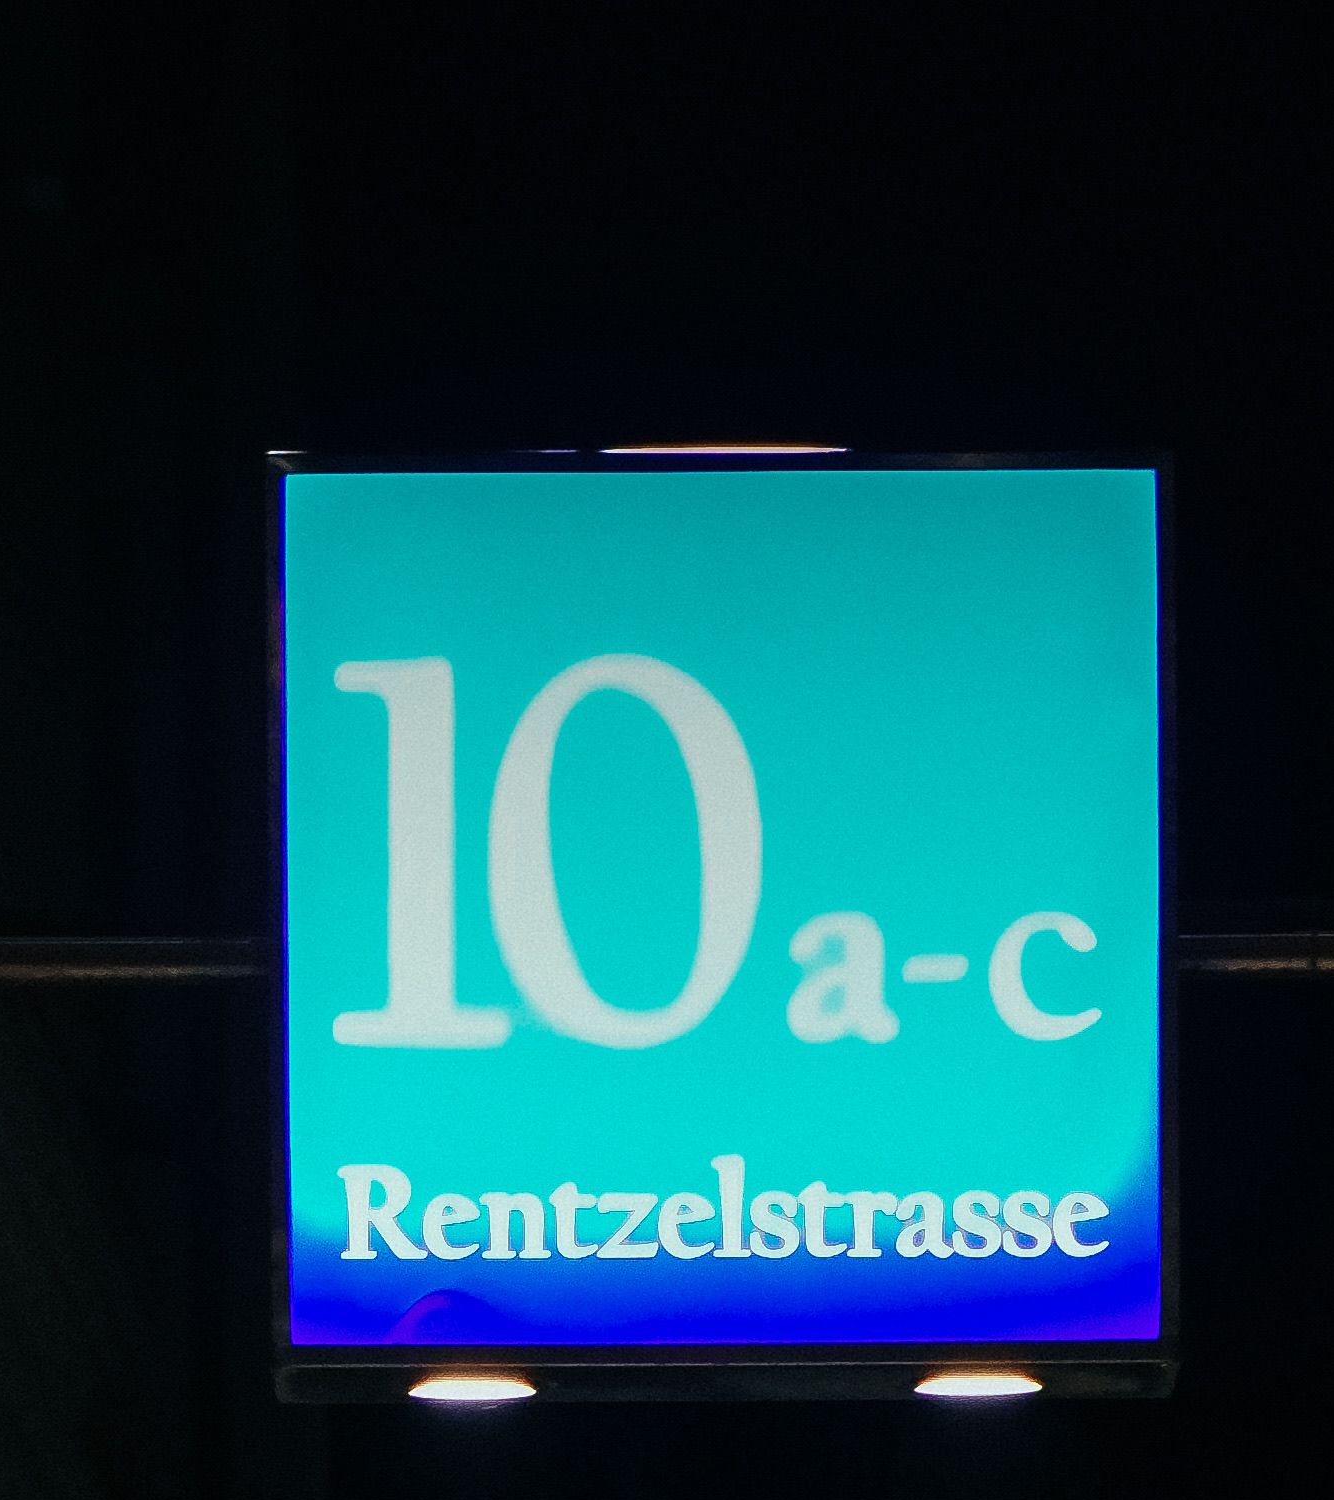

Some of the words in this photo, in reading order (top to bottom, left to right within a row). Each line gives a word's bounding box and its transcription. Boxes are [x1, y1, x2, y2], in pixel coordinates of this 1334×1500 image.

[332, 653, 764, 1050] 10
[785, 910, 1103, 1045] a-c
[336, 1153, 1110, 1262] Rentzelstrasse
